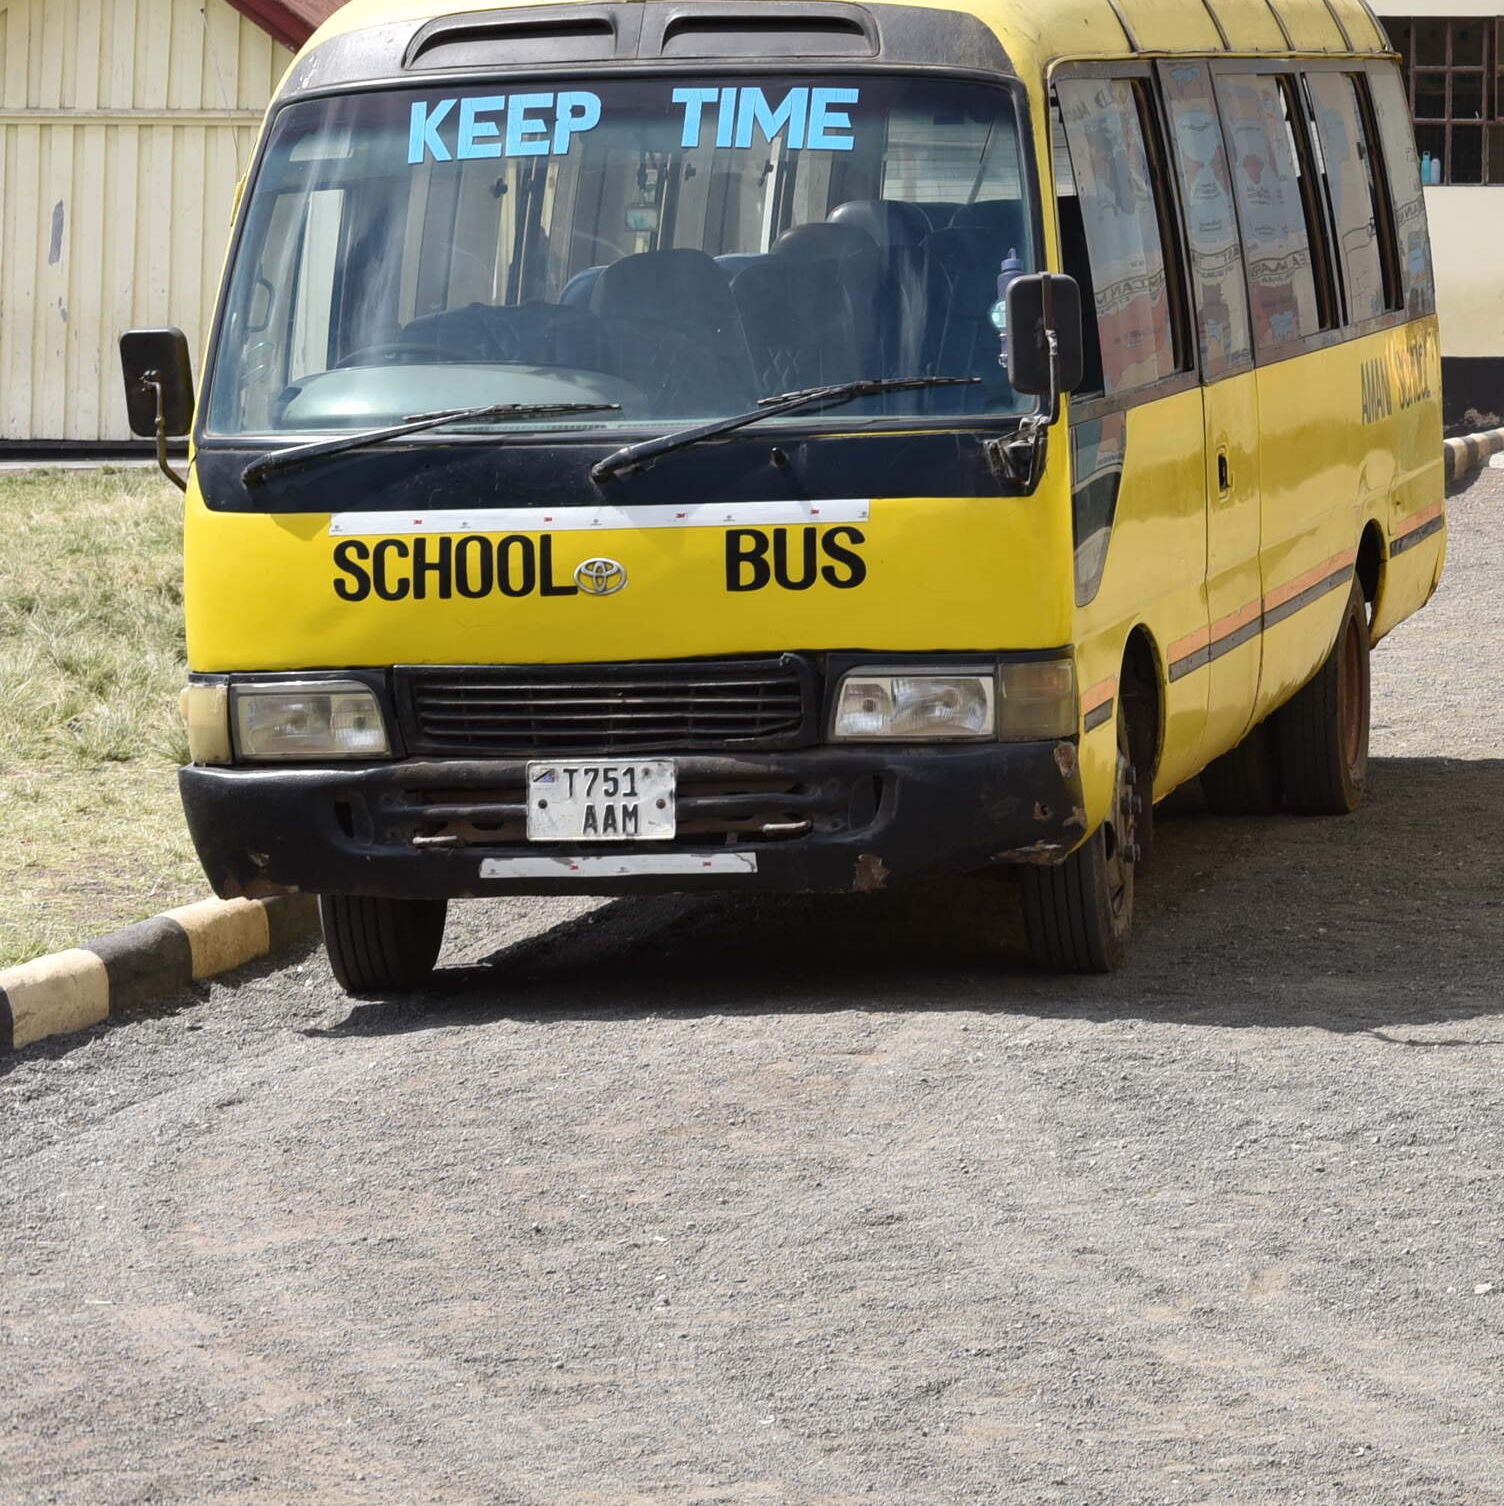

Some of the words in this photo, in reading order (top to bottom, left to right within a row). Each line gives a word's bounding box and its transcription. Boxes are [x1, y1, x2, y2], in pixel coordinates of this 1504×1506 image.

[407, 91, 602, 164] KEEP
[672, 87, 859, 151] TIME
[332, 533, 579, 602] SCHOOL
[725, 526, 867, 592] BUS
[583, 804, 639, 834] AAM
